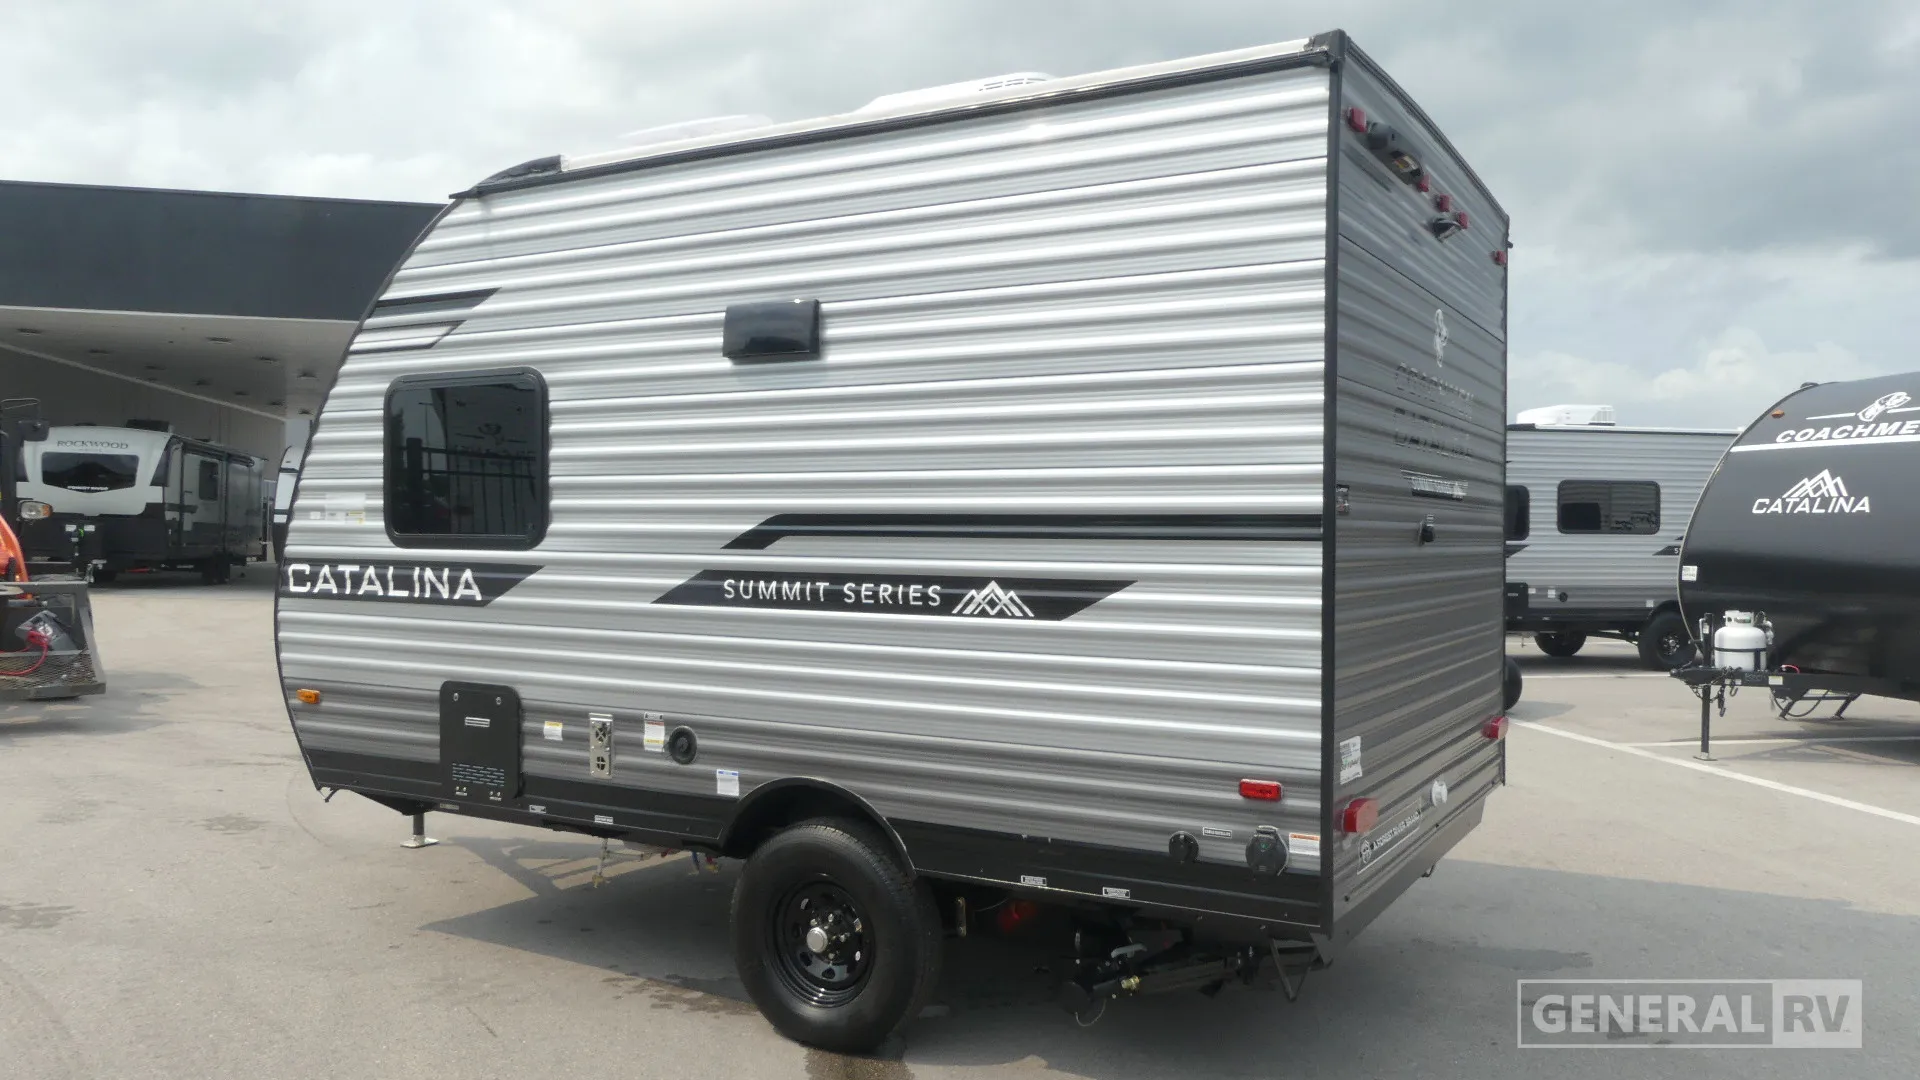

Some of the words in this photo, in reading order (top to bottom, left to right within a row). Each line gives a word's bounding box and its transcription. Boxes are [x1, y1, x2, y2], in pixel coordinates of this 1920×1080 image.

[56, 440, 129, 450] ROCKWOOD
[1752, 496, 1871, 514] CATALINA
[287, 563, 483, 601] CATALINA
[723, 578, 830, 601] SUMMIT
[843, 582, 941, 606] SERIES
